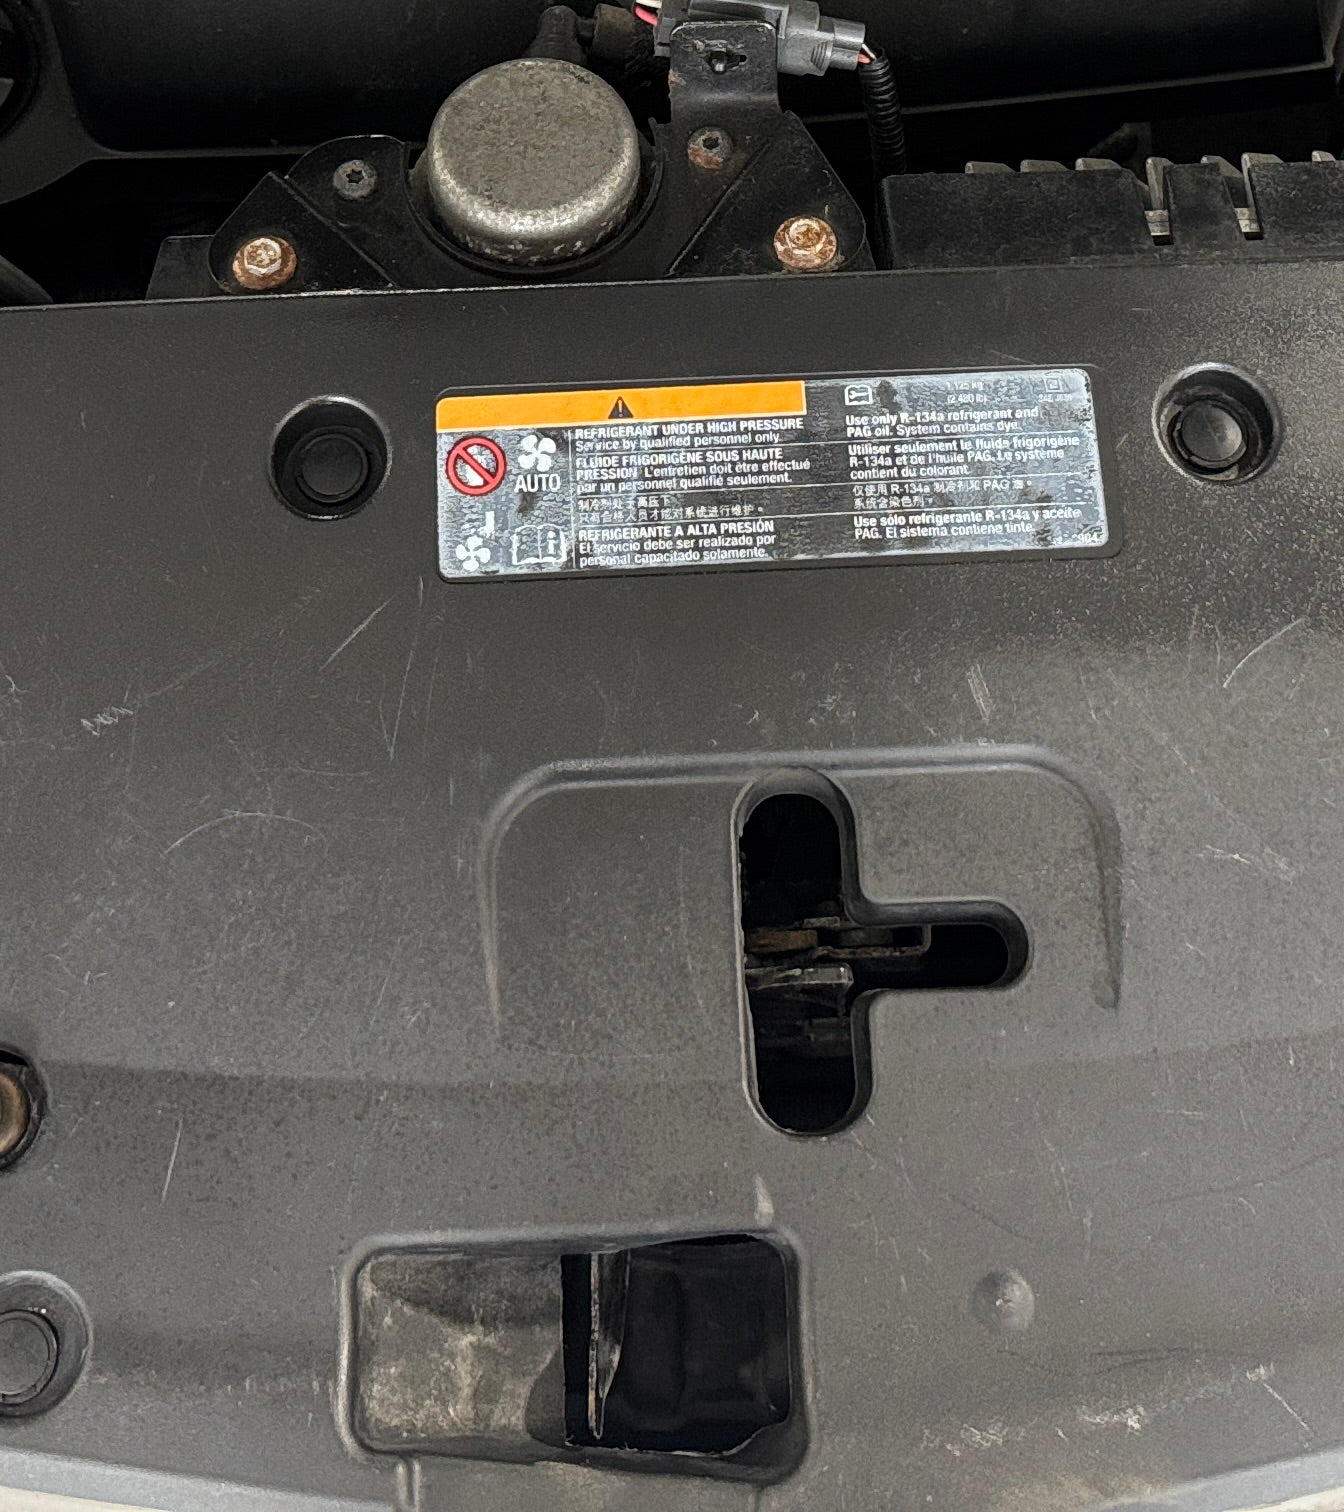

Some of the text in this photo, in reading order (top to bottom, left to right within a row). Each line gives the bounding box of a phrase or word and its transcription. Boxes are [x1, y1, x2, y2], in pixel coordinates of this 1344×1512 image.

[846, 407, 1038, 426] Use only R-134a refrigerant and
[576, 418, 804, 440] REFRIGERANT UNDER HIGH PRESSURE
[847, 426, 871, 437] PAG
[875, 425, 893, 436] oil.
[896, 424, 940, 438] System
[944, 421, 993, 433] contains
[576, 438, 619, 452] Service
[622, 438, 637, 452] by
[640, 435, 690, 450] qualified
[694, 432, 751, 448] personnel
[848, 443, 891, 455] Utiliser
[894, 440, 957, 453] seulement
[961, 439, 973, 450] le
[1012, 435, 1080, 451] frigorigène
[576, 448, 783, 469] FLUIDE FRIGORIGÈNE SOUS HAUTE
[850, 455, 892, 467] R-134a
[896, 455, 907, 465] et
[910, 454, 925, 464] de
[929, 452, 964, 464] l'huile
[1015, 447, 1064, 462] système
[645, 463, 706, 478] L'entretien
[710, 462, 731, 474] doit
[735, 460, 758, 473] être
[762, 458, 810, 471] effectué
[850, 467, 898, 480] contient
[901, 466, 917, 477] du
[514, 473, 561, 493] AUTO
[577, 471, 793, 495] par un personnel qualifié seulement.
[891, 483, 930, 495] R-134a
[983, 480, 1009, 490] PAG
[854, 515, 877, 528] Use
[880, 514, 905, 526] sólo
[909, 512, 982, 528] refrigerante
[986, 509, 1030, 522] R-134a
[1043, 507, 1081, 519] aceite
[578, 518, 775, 541] REFRIGERANTE A ALTA PRESIÓN
[855, 528, 882, 539] PAG.
[886, 527, 897, 538] El
[905, 524, 948, 538] sistema
[951, 523, 1003, 536] contiene
[579, 534, 775, 554] El servicio debe ser realizado por
[580, 547, 769, 568] personal capacitado solamente.
